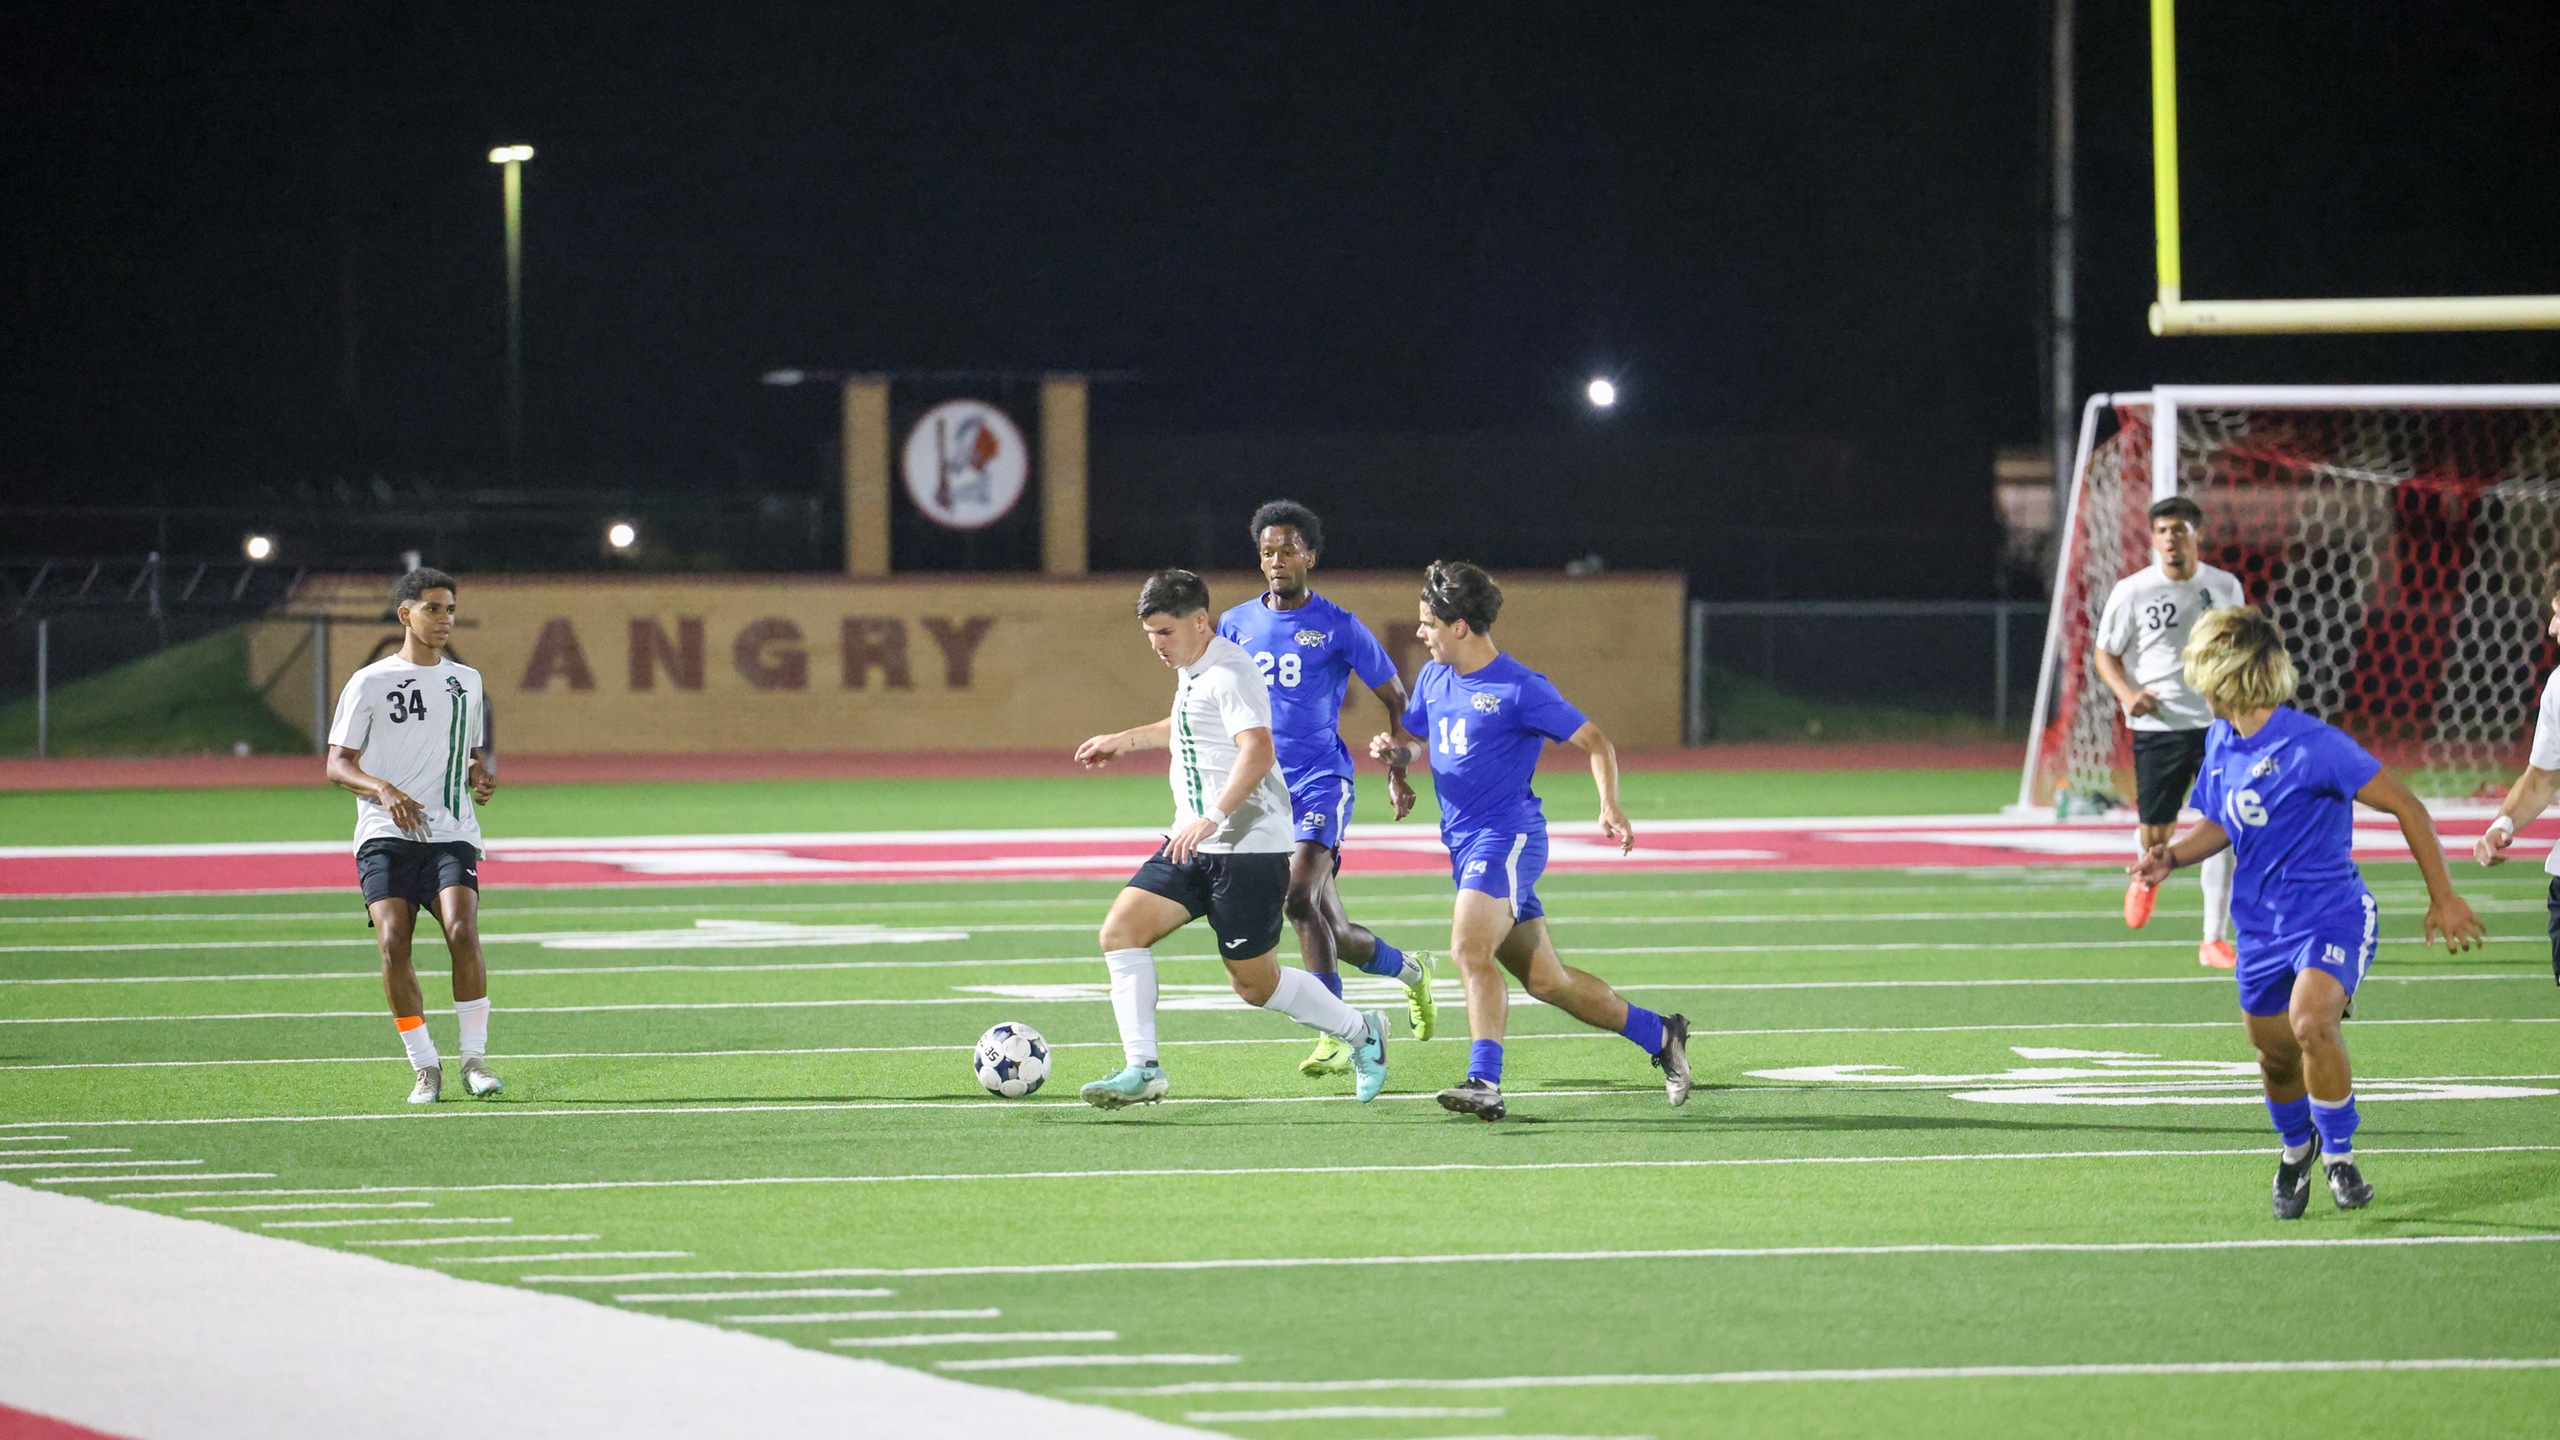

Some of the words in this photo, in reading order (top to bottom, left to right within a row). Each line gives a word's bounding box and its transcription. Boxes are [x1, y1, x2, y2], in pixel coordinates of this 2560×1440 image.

[2145, 602, 2178, 630] 32
[519, 615, 996, 690] ANGRY
[1253, 651, 1302, 688] 28
[386, 689, 427, 724] 34
[1438, 717, 1468, 756] 14
[1302, 811, 1326, 827] 28
[1467, 860, 1488, 874] 14
